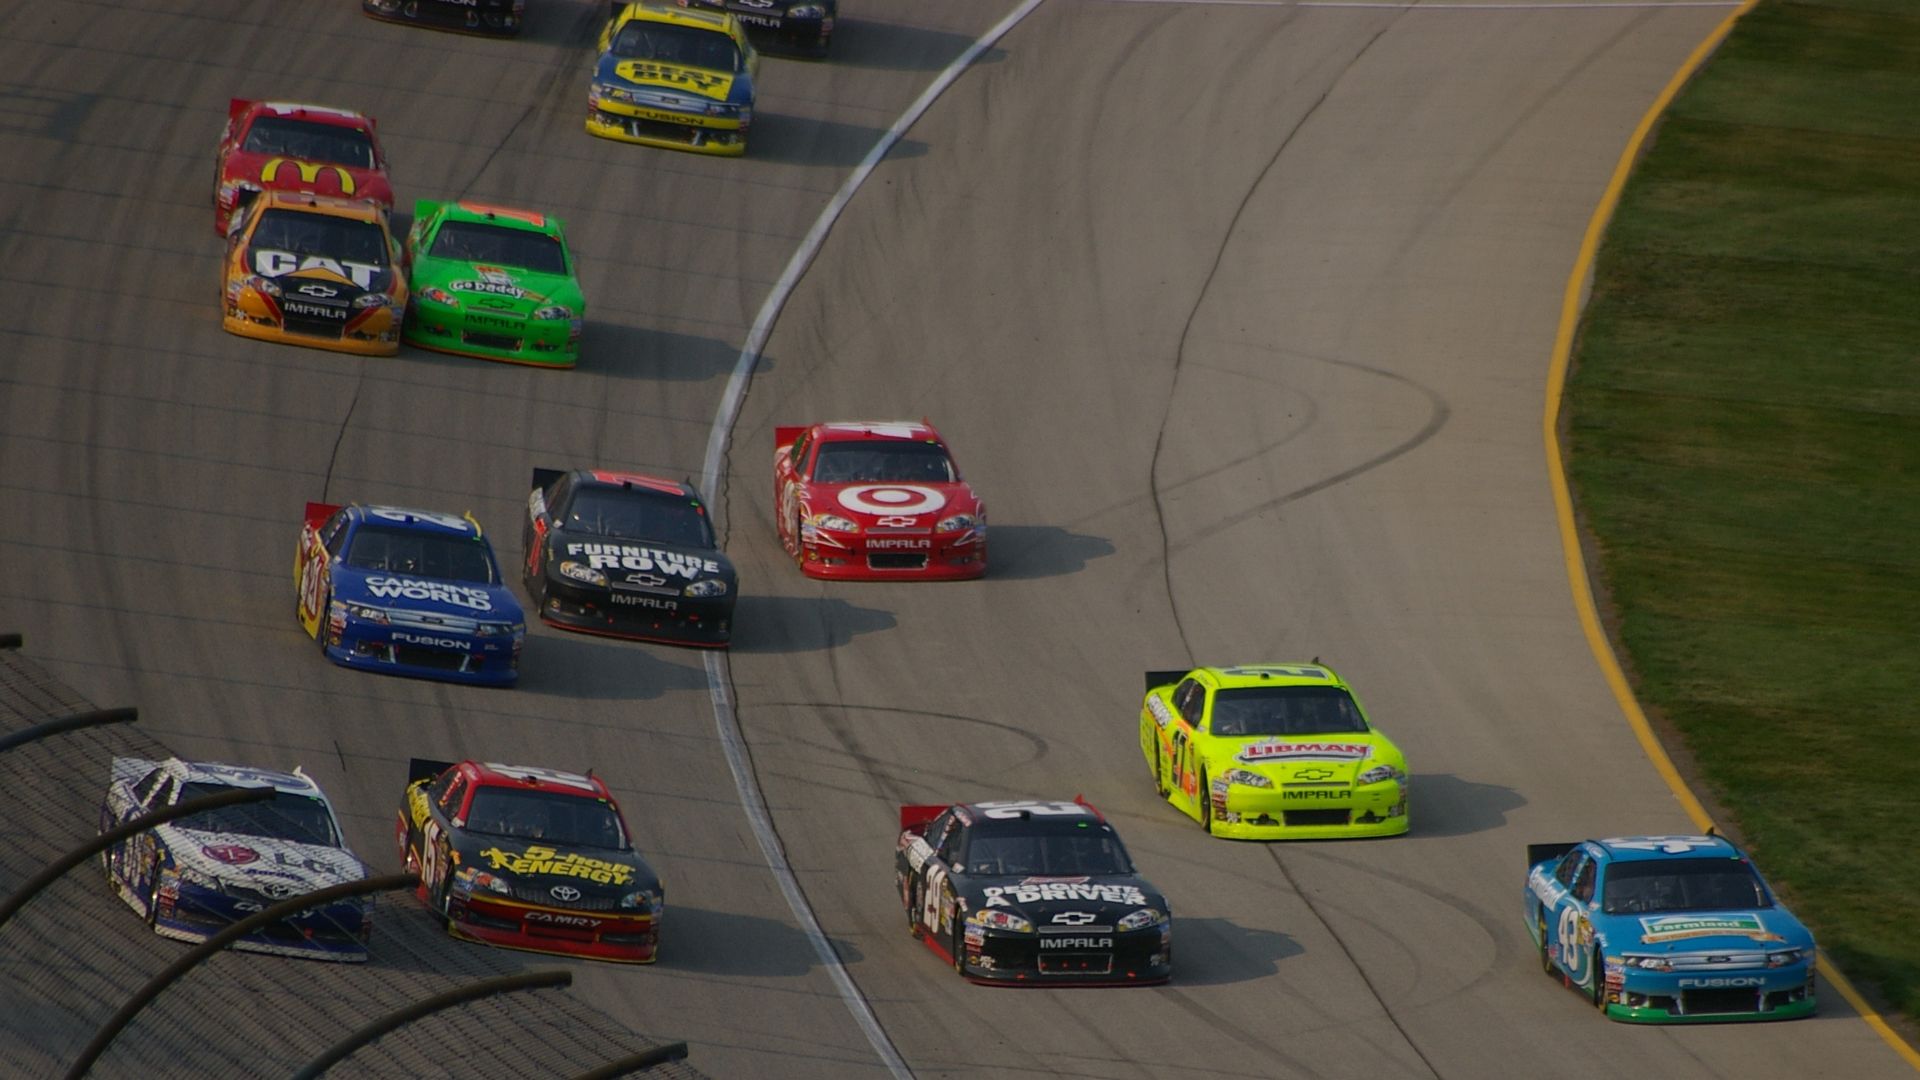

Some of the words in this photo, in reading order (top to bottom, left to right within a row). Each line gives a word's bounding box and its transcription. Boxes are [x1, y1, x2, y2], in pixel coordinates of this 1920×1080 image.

[634, 110, 704, 125] FUSION
[255, 250, 380, 291] CAT
[284, 302, 347, 319] IMPALA
[464, 314, 526, 331] IMPALA
[866, 539, 931, 549] IMPALA
[567, 543, 720, 573] FURNITURE
[589, 555, 699, 580] ROW
[364, 577, 490, 600] CAMPING
[367, 586, 492, 611] WORLD
[611, 594, 678, 610] IMPALA
[391, 632, 471, 649] FUSION
[1247, 744, 1368, 757] LIBMAN
[1282, 790, 1349, 800] IMPALA
[524, 846, 636, 873] 5-hour
[512, 860, 632, 885] ENERGY
[983, 884, 1139, 897] DESIGNATE
[985, 896, 1011, 907] A
[1014, 889, 1147, 906] DRIVER
[524, 911, 603, 928] CAMRY
[1652, 920, 1740, 932] Farmland
[1040, 939, 1113, 949] IMPALA
[1559, 906, 1579, 972] 43
[1679, 977, 1765, 989] FUSION
